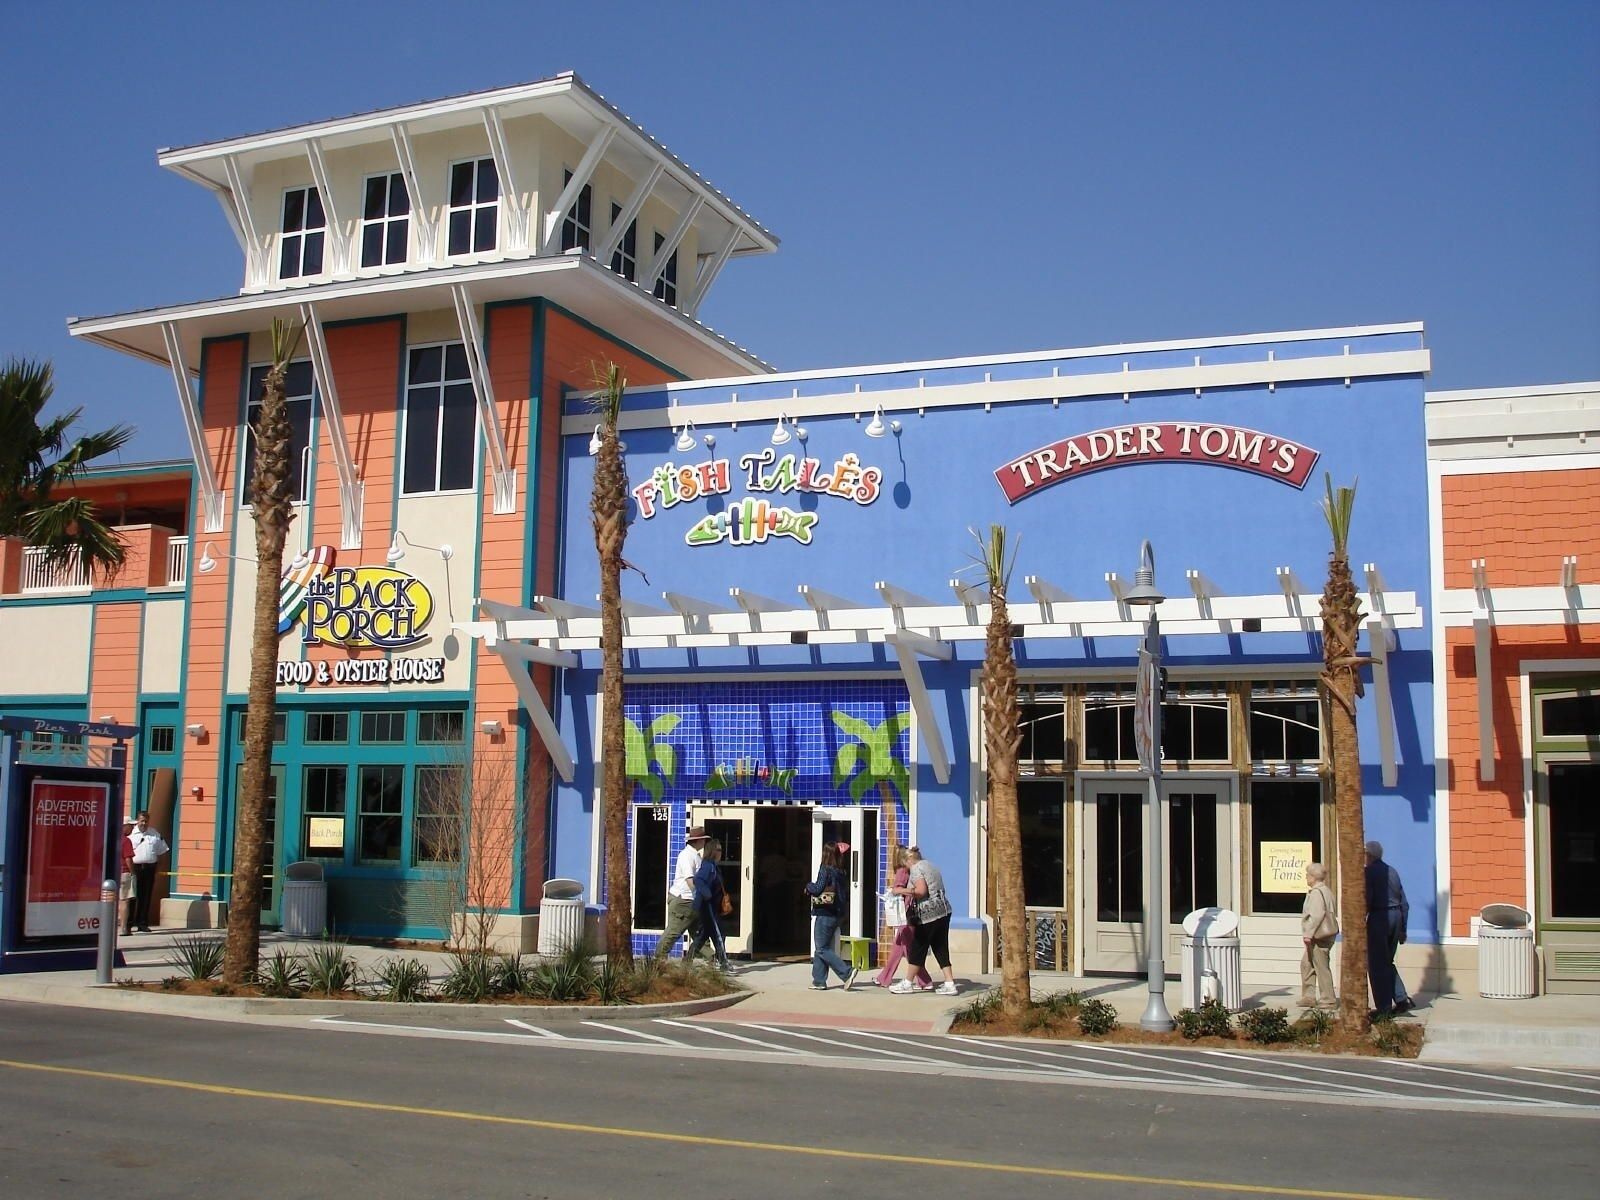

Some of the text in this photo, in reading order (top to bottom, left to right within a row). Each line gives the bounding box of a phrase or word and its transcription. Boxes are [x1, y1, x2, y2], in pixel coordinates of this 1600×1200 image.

[1011, 424, 1298, 487] TRADER TOM'S
[740, 451, 879, 502] TALES
[308, 568, 416, 610] the BACK
[302, 596, 428, 647] PORCH
[317, 660, 331, 683] &
[334, 659, 389, 682] OYSTER
[392, 657, 442, 681] HOUSE
[35, 719, 113, 736] Pier Park
[36, 800, 98, 813] ADVERTISE
[35, 813, 97, 827] HERE NOW.
[652, 812, 668, 821] 125
[1268, 855, 1307, 868] Trader
[1271, 868, 1303, 881] Toms
